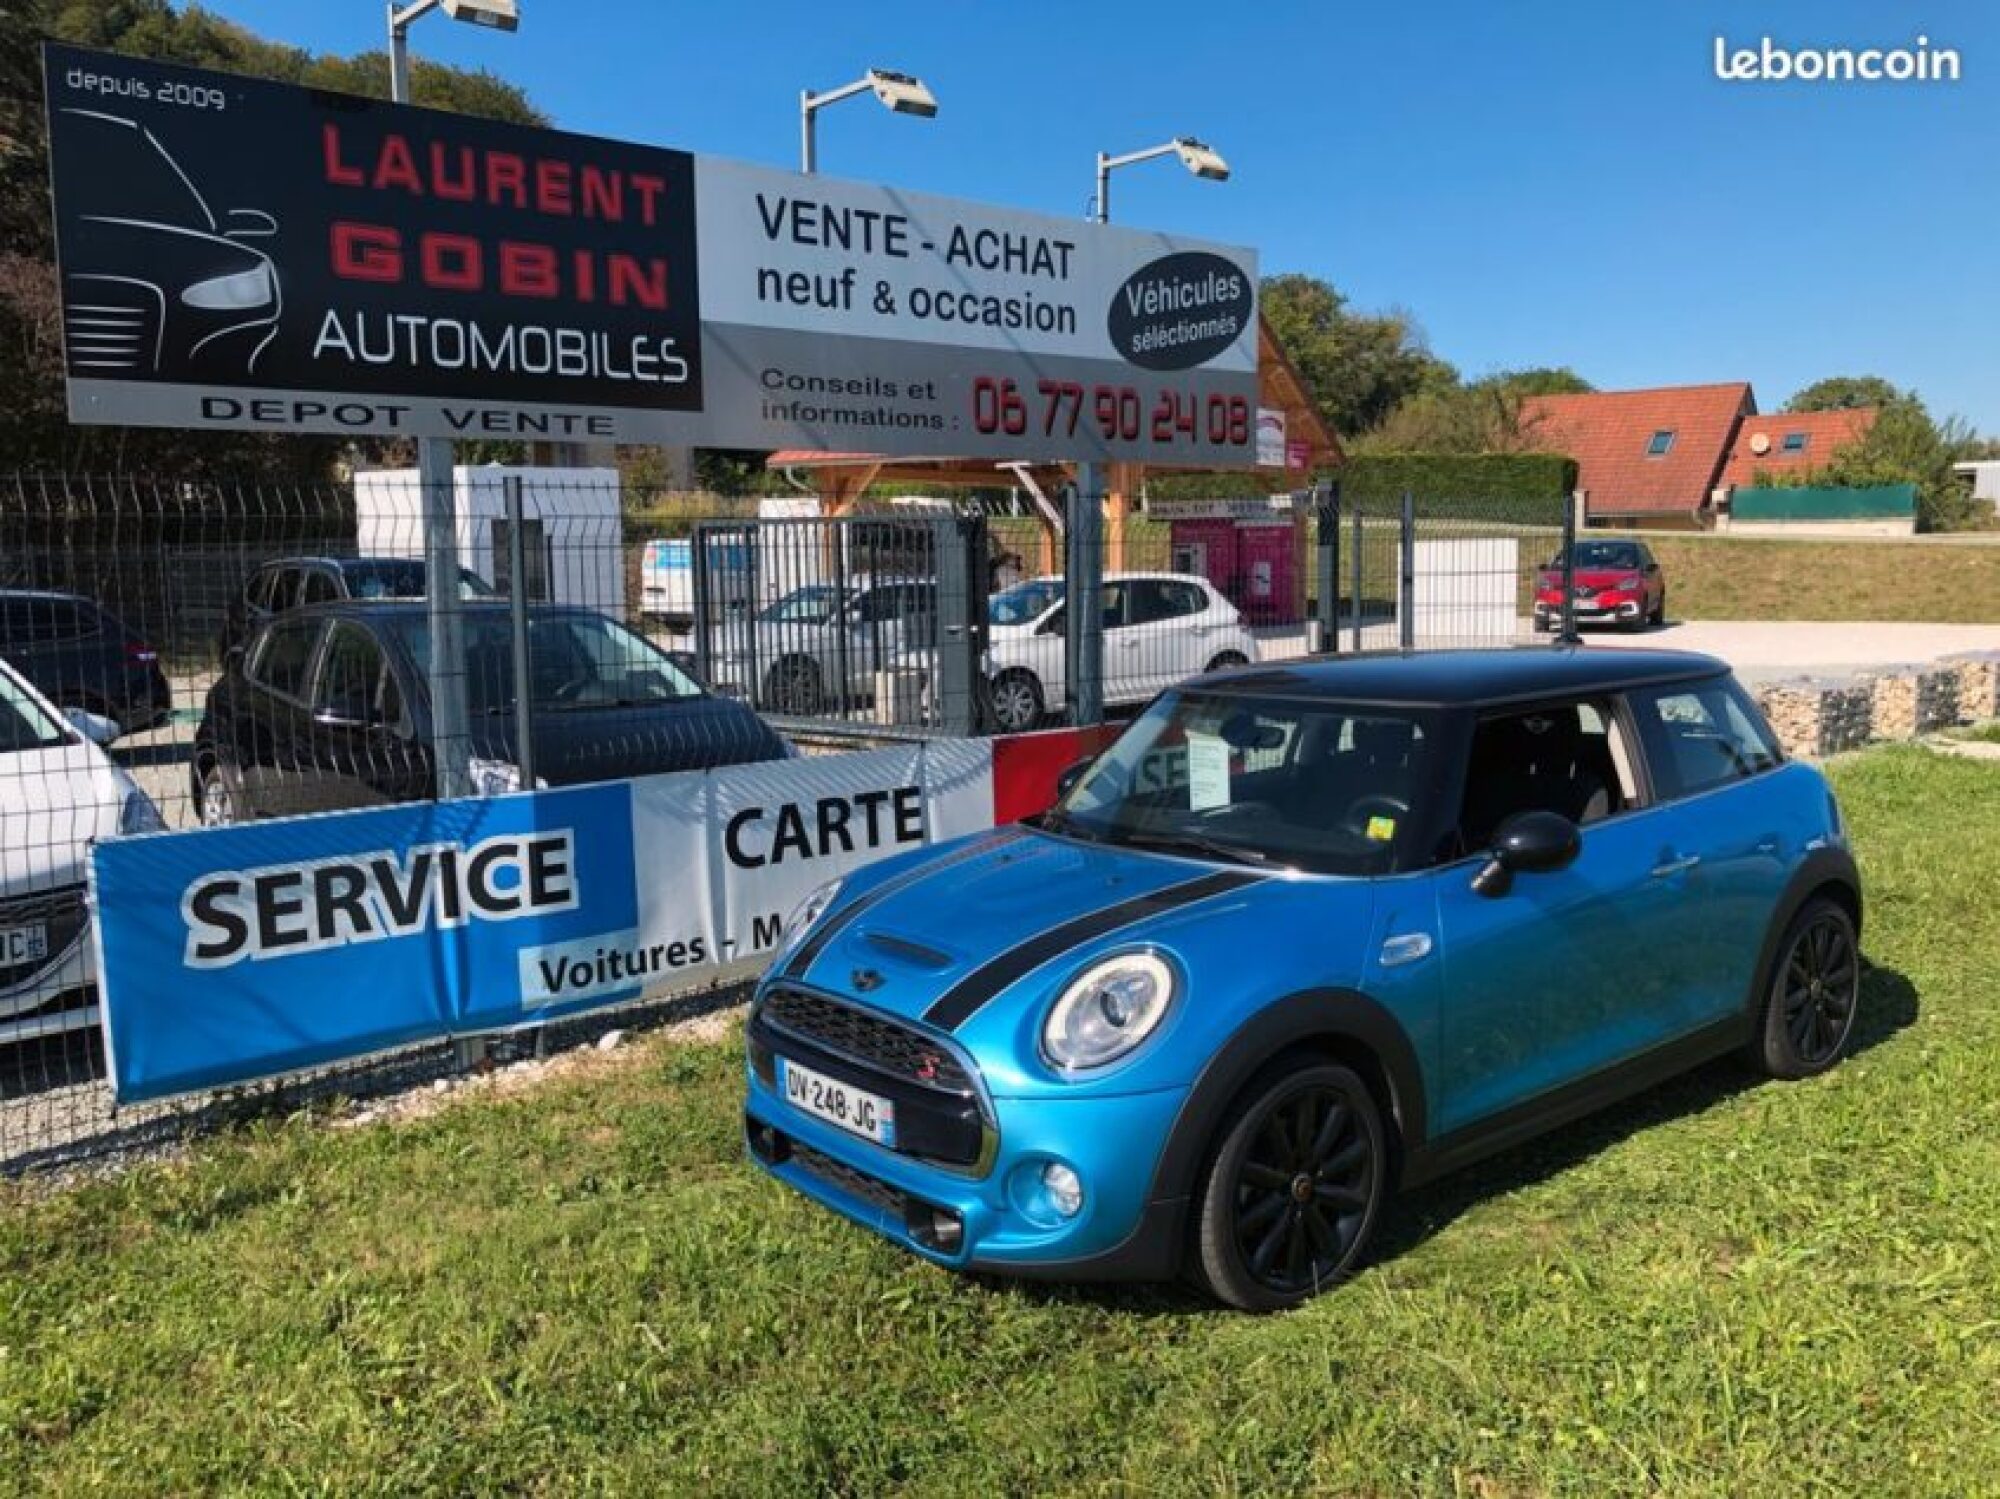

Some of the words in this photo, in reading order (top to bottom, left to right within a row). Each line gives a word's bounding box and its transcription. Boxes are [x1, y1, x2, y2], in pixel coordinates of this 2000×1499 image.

[66, 67, 150, 98] depuis
[157, 82, 226, 111] 2009
[323, 122, 667, 228] LAURENT
[329, 220, 669, 311] GOBIN
[755, 193, 909, 258] VENTE
[946, 224, 1076, 280] ACHAT
[757, 267, 857, 310] neuf
[873, 280, 896, 315] &
[908, 289, 1077, 335] occasion
[1126, 271, 1242, 318] Véhicules
[312, 308, 688, 384] AUTOMOBILES
[200, 397, 411, 428] DEPOT
[440, 407, 617, 436] VENTE
[760, 367, 899, 398] Conseils
[907, 381, 937, 400] et
[762, 399, 944, 430] informations
[972, 376, 1027, 435] 06
[1037, 378, 1084, 438] 77
[1095, 383, 1141, 442] 90
[1152, 388, 1198, 444] 24
[1208, 393, 1250, 445] 08
[725, 786, 925, 870] CARTE
[190, 837, 572, 960] SERVICE
[538, 937, 705, 994] Voitures
[787, 1065, 878, 1133] DV-248-JG
